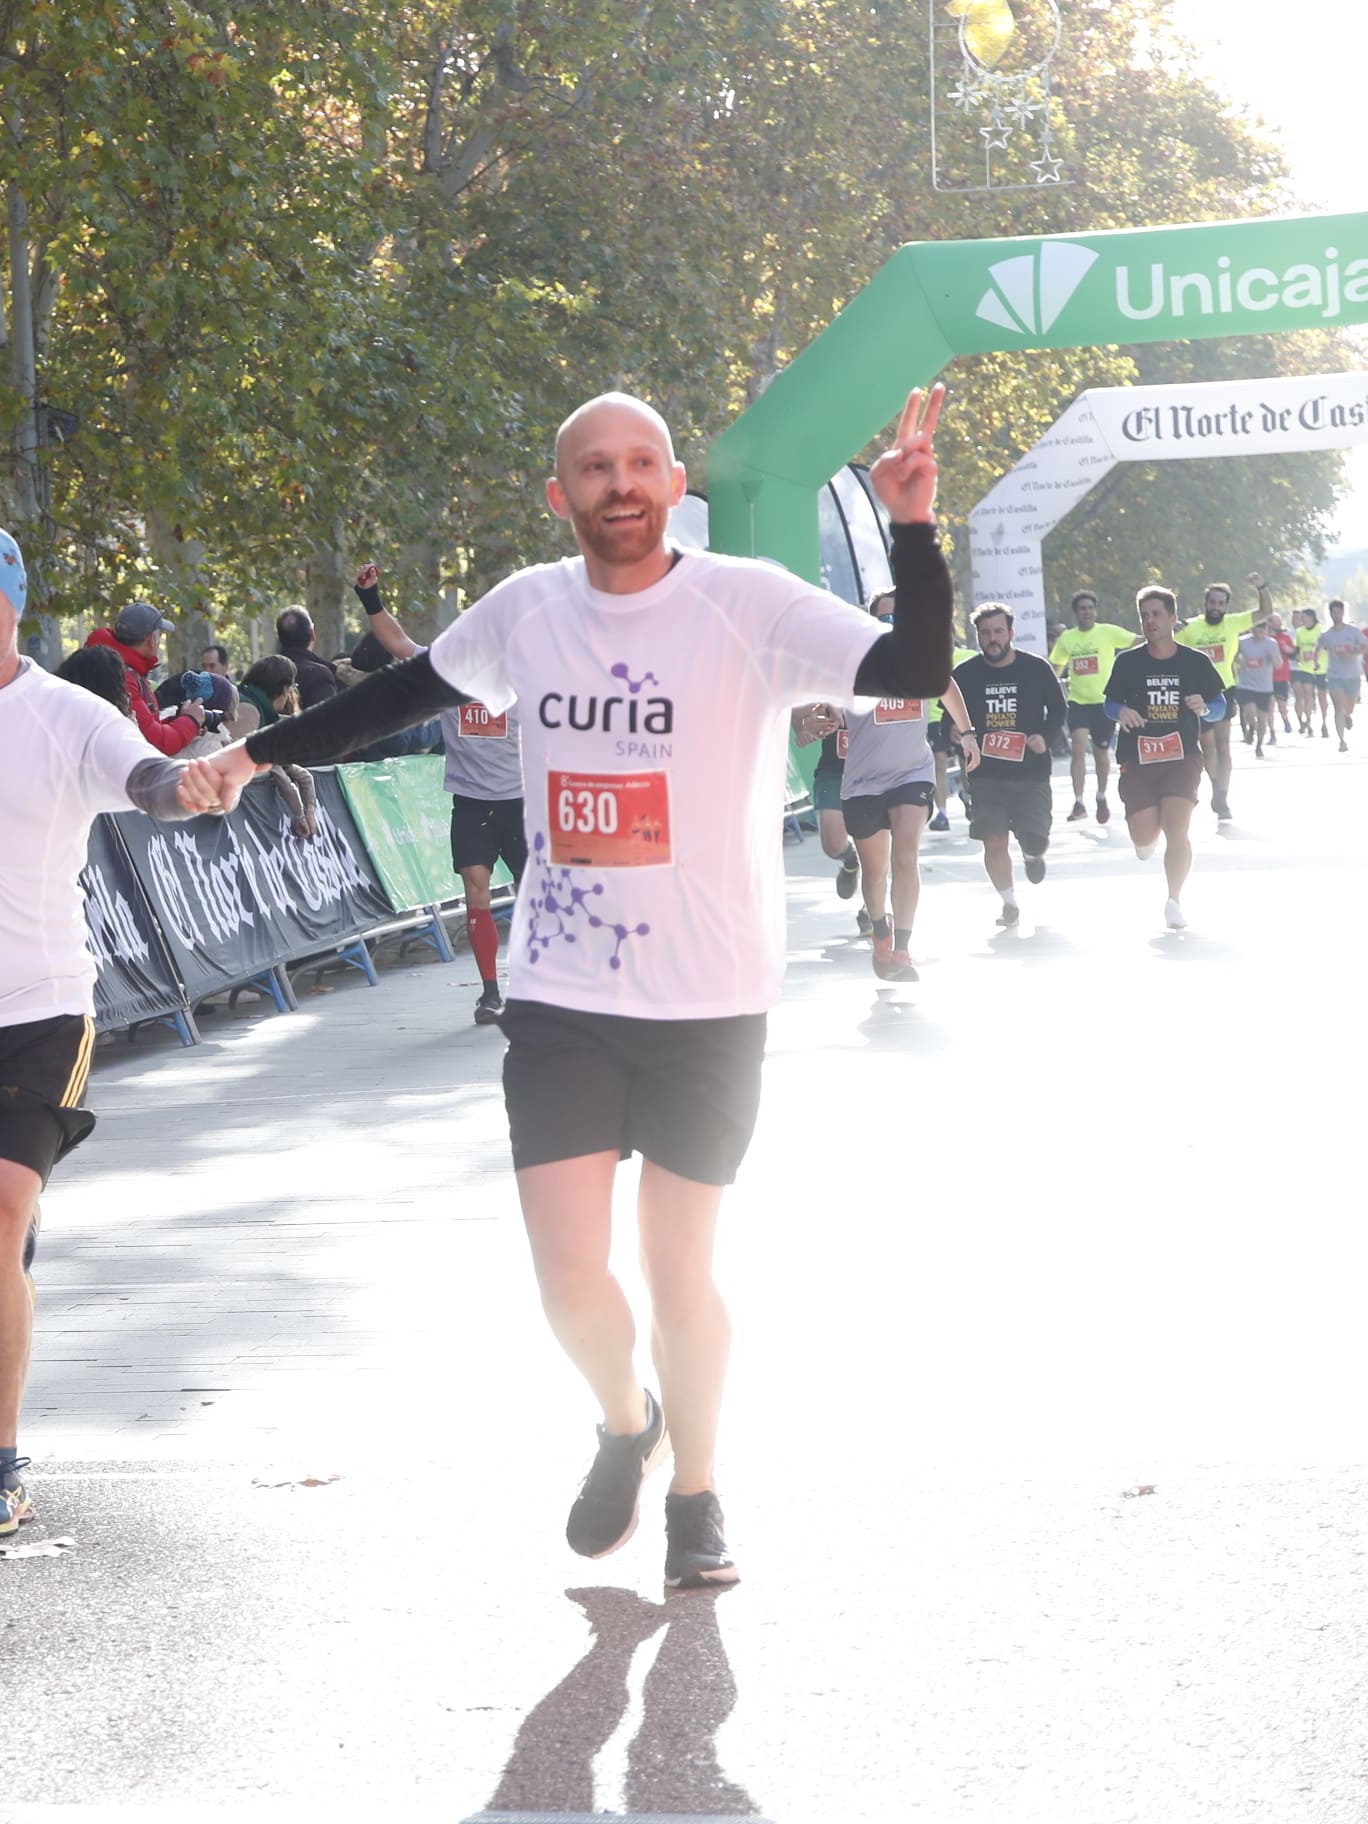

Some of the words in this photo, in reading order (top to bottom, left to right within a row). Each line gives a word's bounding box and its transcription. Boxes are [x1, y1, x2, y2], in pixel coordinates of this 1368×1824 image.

[1115, 246, 1368, 321] Unicaja
[1122, 406, 1163, 441] El
[1169, 404, 1253, 440] Norte
[1259, 402, 1292, 433] de
[1298, 395, 1368, 432] Cas
[985, 685, 1018, 695] BELIEVE
[1146, 678, 1180, 687] BELIEVE
[985, 698, 1018, 713] THE
[1147, 691, 1180, 705] THE
[465, 708, 489, 724] 410
[539, 692, 674, 734] curia
[1147, 705, 1179, 713] POTATO
[1148, 711, 1179, 720] POWER
[985, 713, 1017, 721] POTATO
[985, 720, 1017, 728] POWER
[615, 740, 673, 758] SPAIN
[988, 735, 1010, 750] 372
[1143, 742, 1165, 753] 371
[558, 789, 618, 834] 630
[244, 818, 298, 916] de
[175, 820, 271, 944] Norte
[148, 834, 205, 950] El
